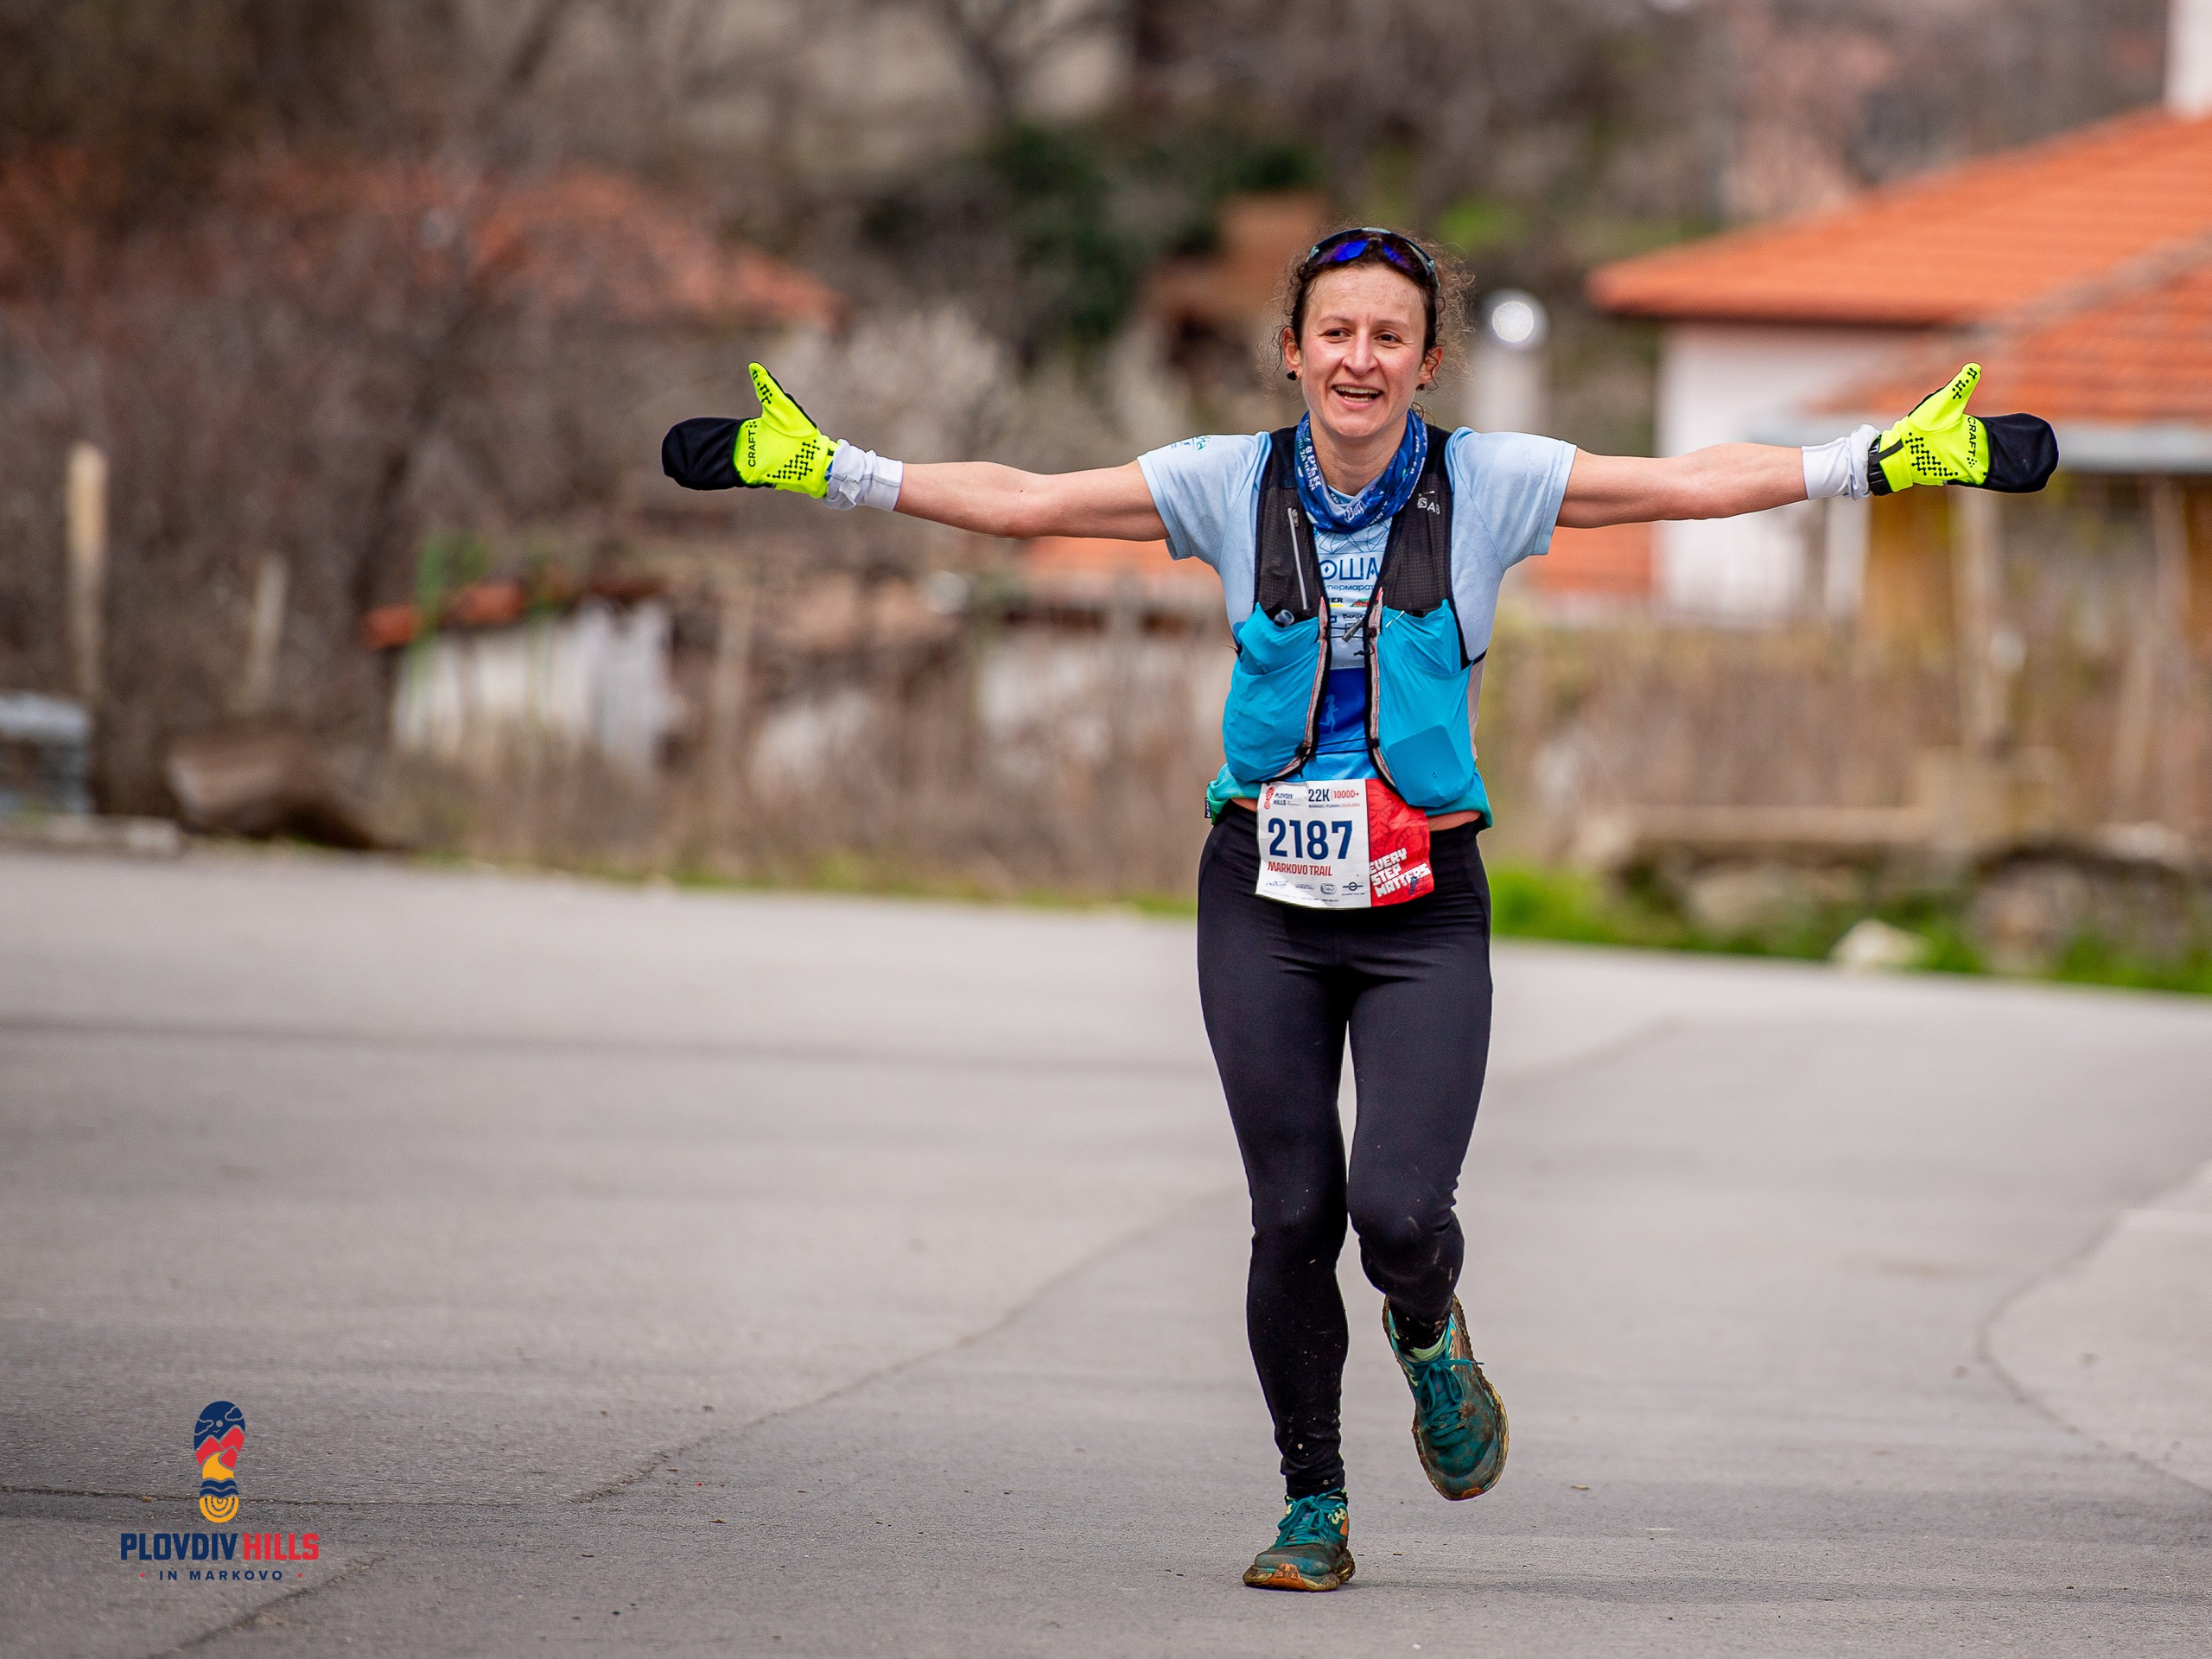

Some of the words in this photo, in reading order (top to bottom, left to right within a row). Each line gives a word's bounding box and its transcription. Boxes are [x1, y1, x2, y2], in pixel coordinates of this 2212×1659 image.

[747, 430, 756, 467] CRAFT
[1967, 416, 1977, 457] CRAFT
[1308, 788, 1330, 802] 22K
[1268, 817, 1353, 860] 2187
[1268, 861, 1308, 874] MARKOVO
[1309, 865, 1332, 876] TRAIL
[1370, 848, 1408, 874] EVERY
[1370, 863, 1402, 887] STEP
[1374, 862, 1432, 898] MATTERS
